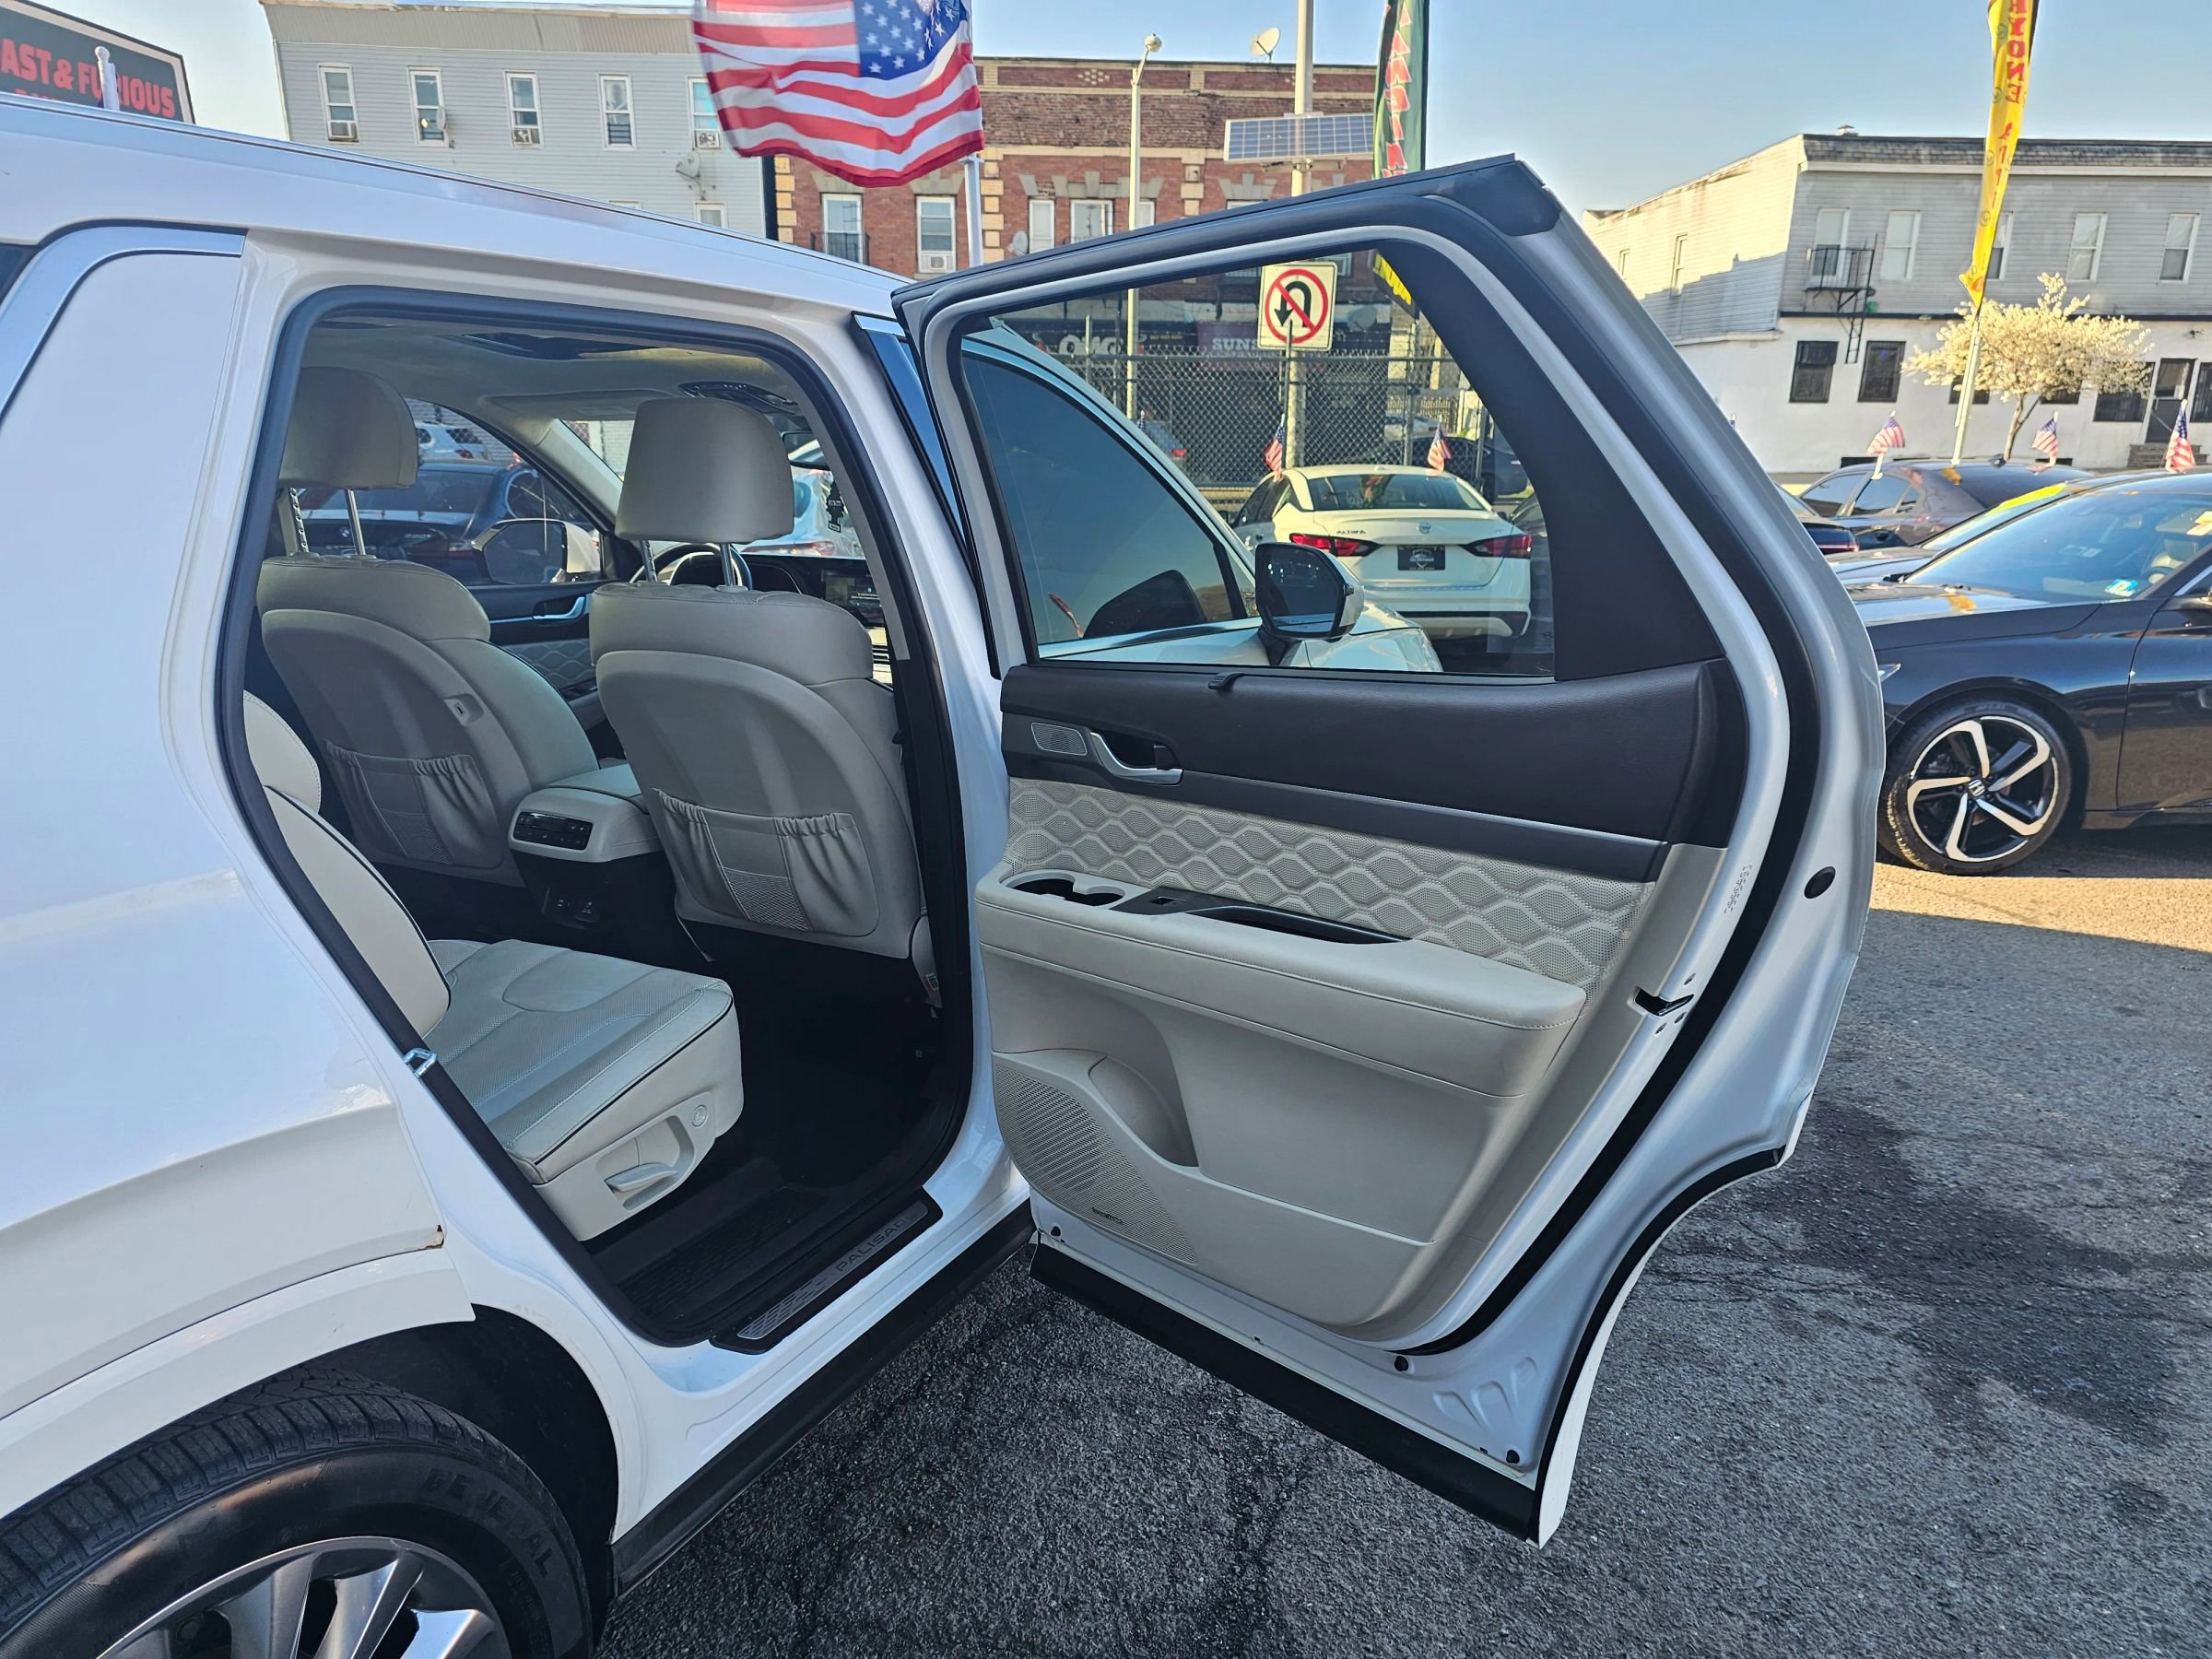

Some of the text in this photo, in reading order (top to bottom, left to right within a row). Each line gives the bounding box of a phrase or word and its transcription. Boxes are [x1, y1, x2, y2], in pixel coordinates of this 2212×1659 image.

[53, 58, 74, 89] &
[77, 61, 175, 118] FUIOUS
[835, 1217, 909, 1272] PALISAD
